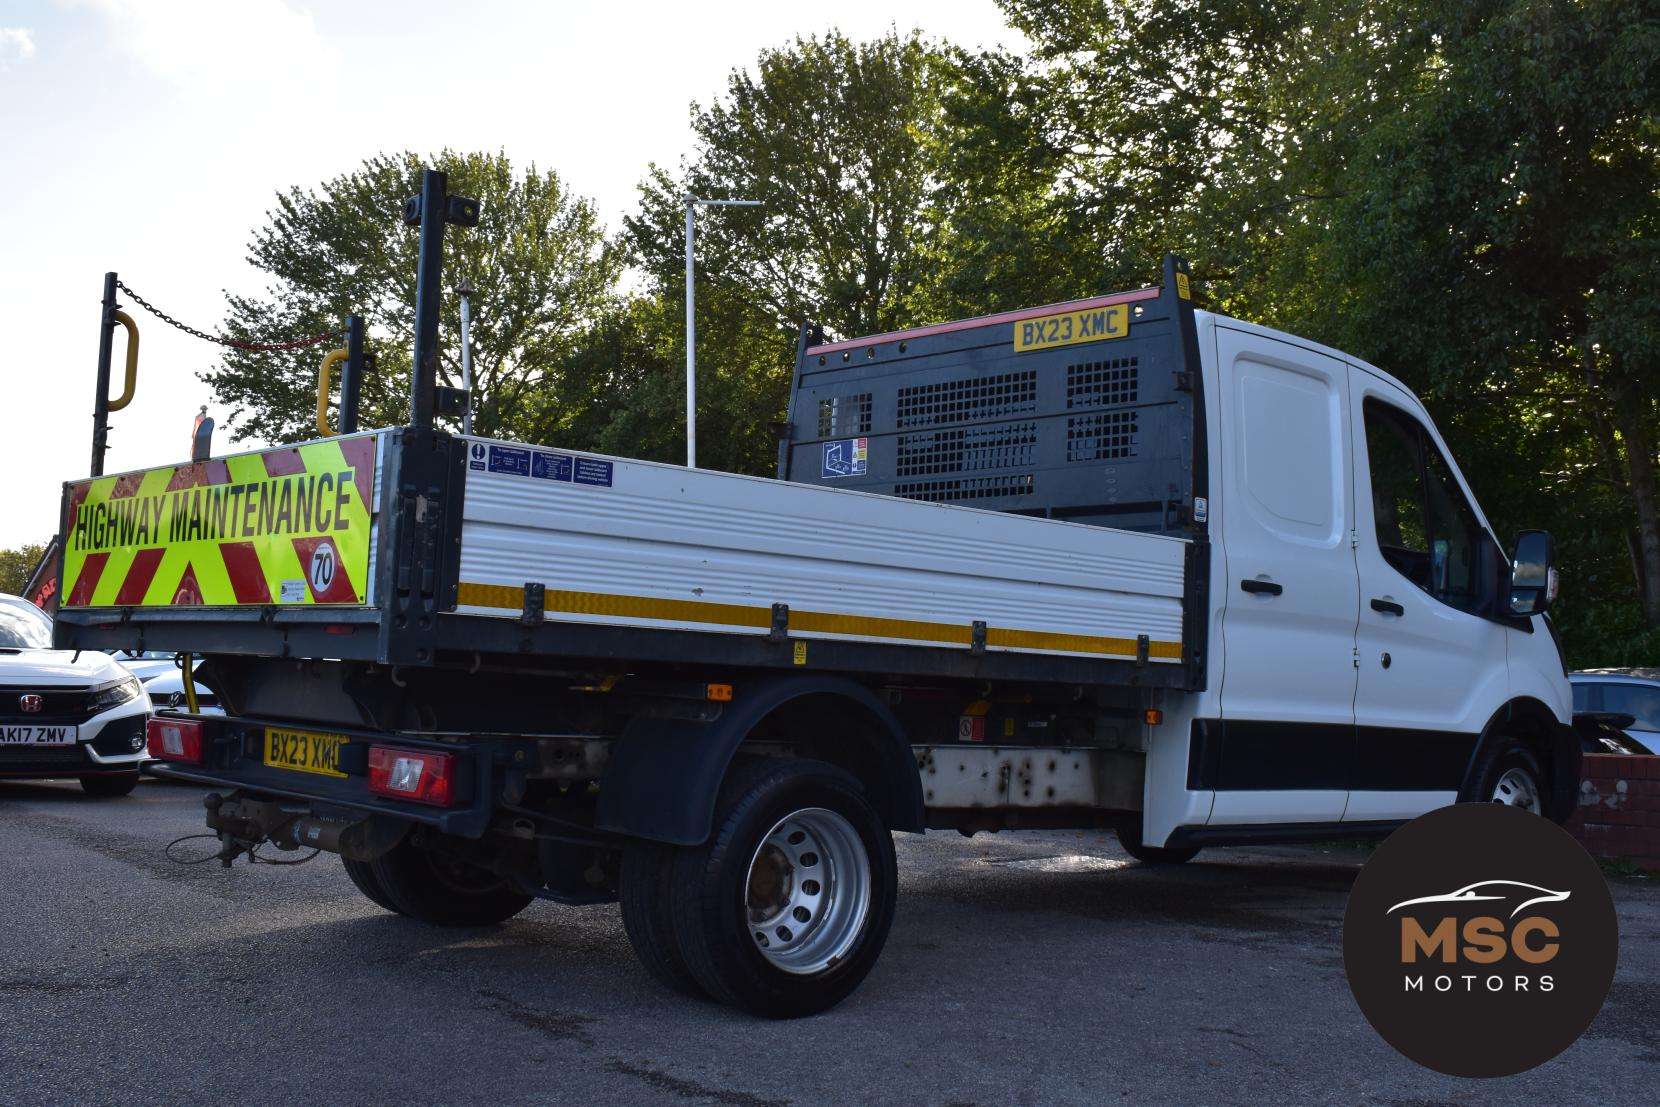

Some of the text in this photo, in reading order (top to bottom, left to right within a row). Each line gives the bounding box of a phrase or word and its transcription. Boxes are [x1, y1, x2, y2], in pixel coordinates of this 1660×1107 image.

[1022, 310, 1118, 346] BX23 XMC
[74, 470, 355, 551] HIGHWAY MAINTENANCE
[314, 551, 333, 586] 70
[0, 727, 67, 743] AK17 ZMV
[270, 732, 308, 766] BX23
